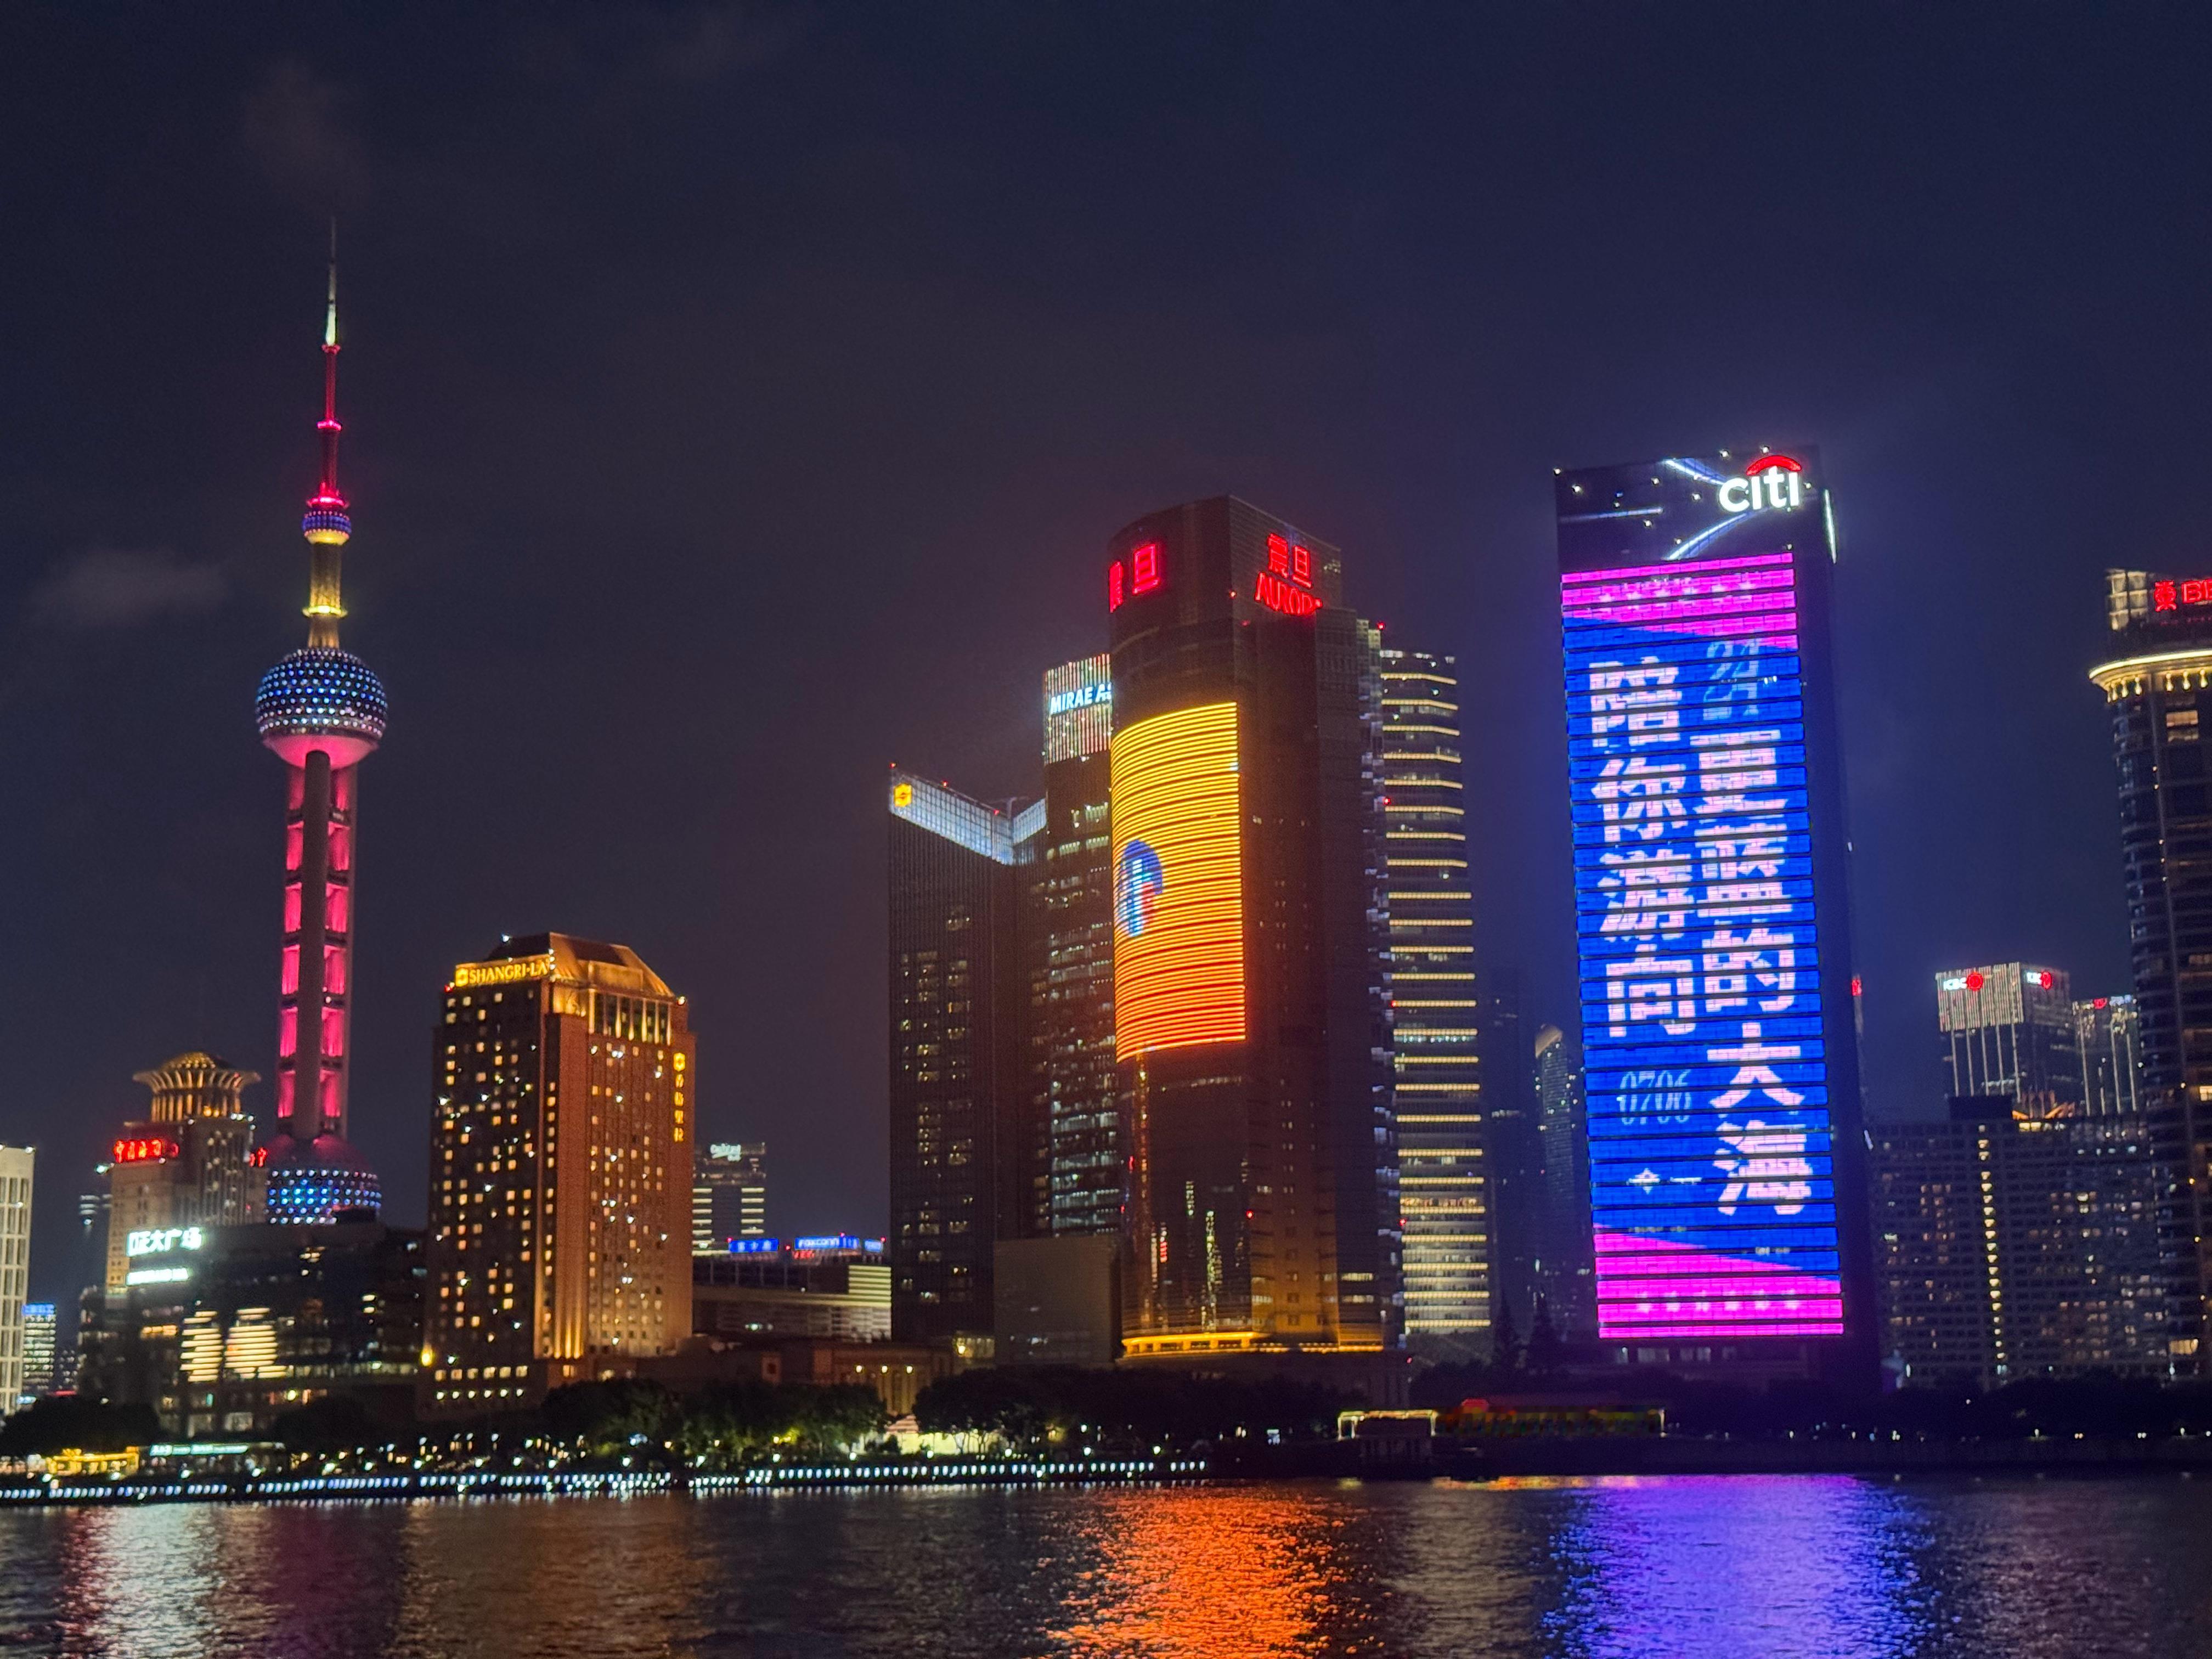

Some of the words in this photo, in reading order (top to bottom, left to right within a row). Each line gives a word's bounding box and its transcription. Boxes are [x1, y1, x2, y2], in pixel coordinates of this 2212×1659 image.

[1719, 465, 1800, 513] citi
[1050, 686, 1093, 715] MIRAE
[1589, 655, 1697, 1037] 陪你游向
[1617, 1069, 1691, 1125] 0706
